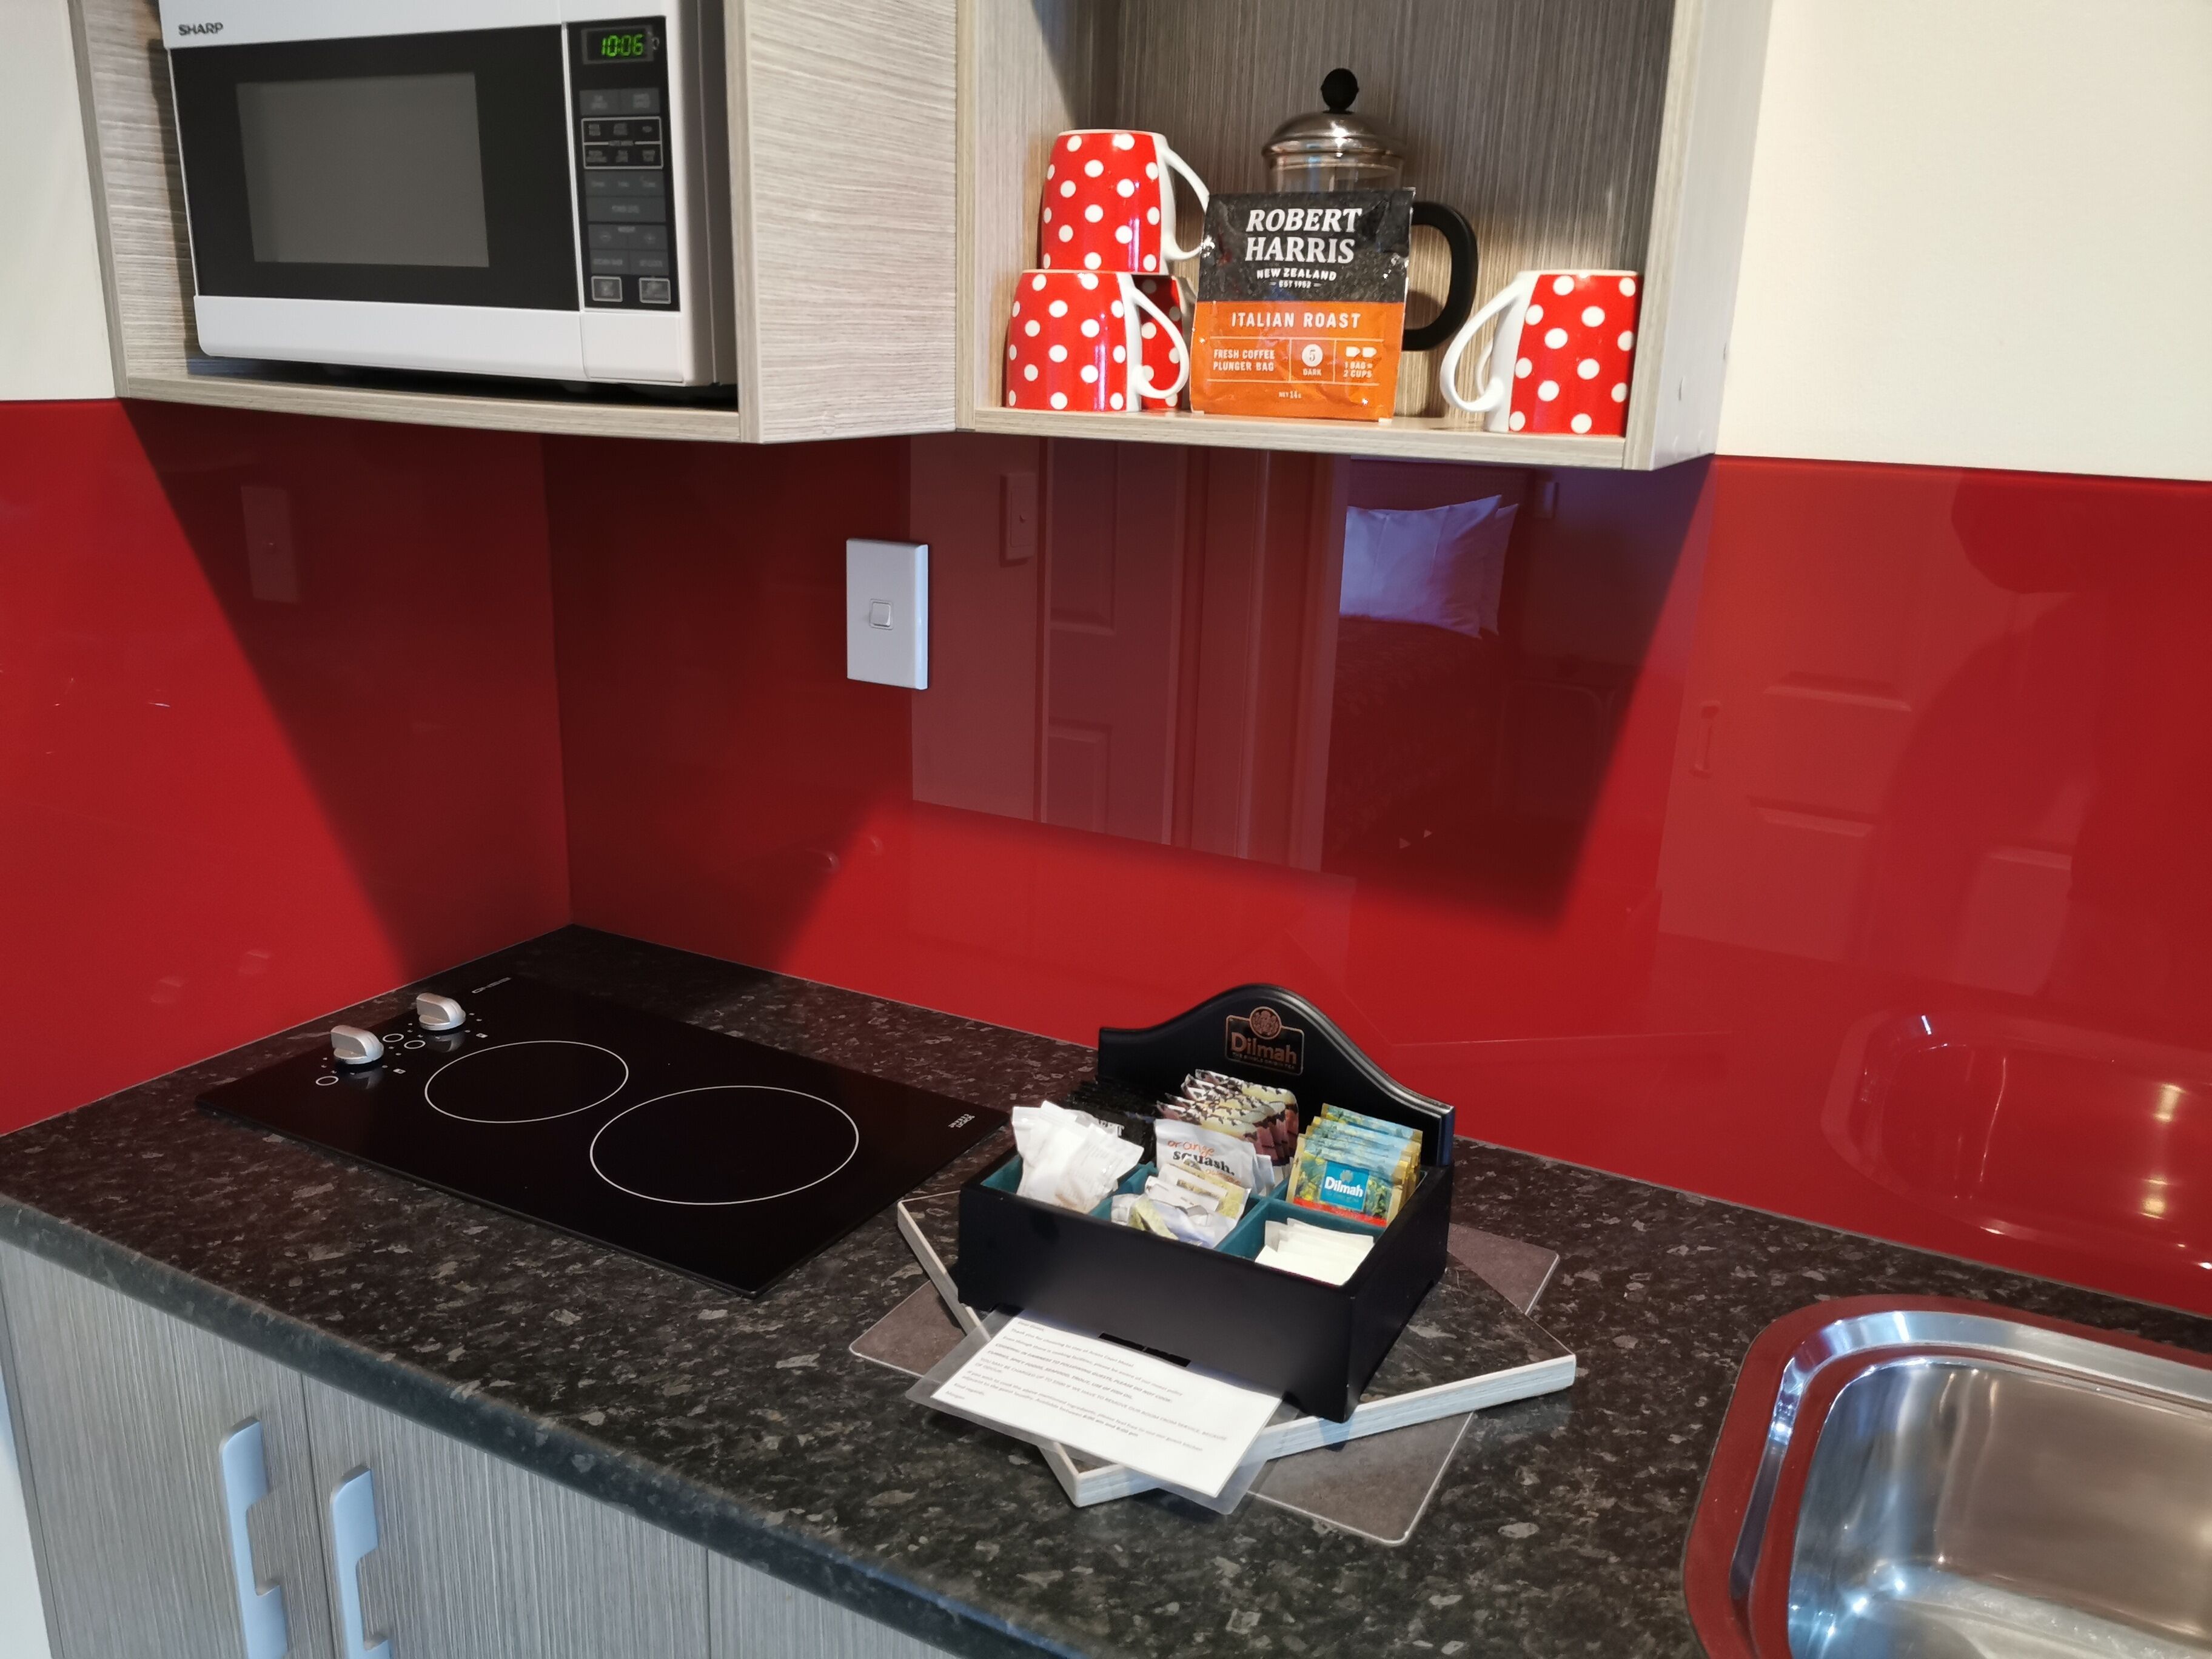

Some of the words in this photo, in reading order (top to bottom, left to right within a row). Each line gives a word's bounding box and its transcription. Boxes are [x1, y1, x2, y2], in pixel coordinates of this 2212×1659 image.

[178, 22, 224, 36] SHARP
[601, 34, 644, 57] 10:06
[1245, 208, 1362, 233] ROBERT
[1245, 236, 1355, 264] HARRIS
[1256, 268, 1281, 279] NEW
[1283, 267, 1337, 281] ZEALAND
[1232, 312, 1295, 328] ITALIAN
[1304, 312, 1361, 329] ROAST
[1213, 349, 1239, 360] FRESH
[1242, 349, 1275, 360] COFFEE
[1213, 361, 1252, 371] PLUNGER
[1256, 361, 1274, 372] BAG
[1231, 1032, 1297, 1064] Dilmah
[1324, 1176, 1363, 1198] Dilmah
